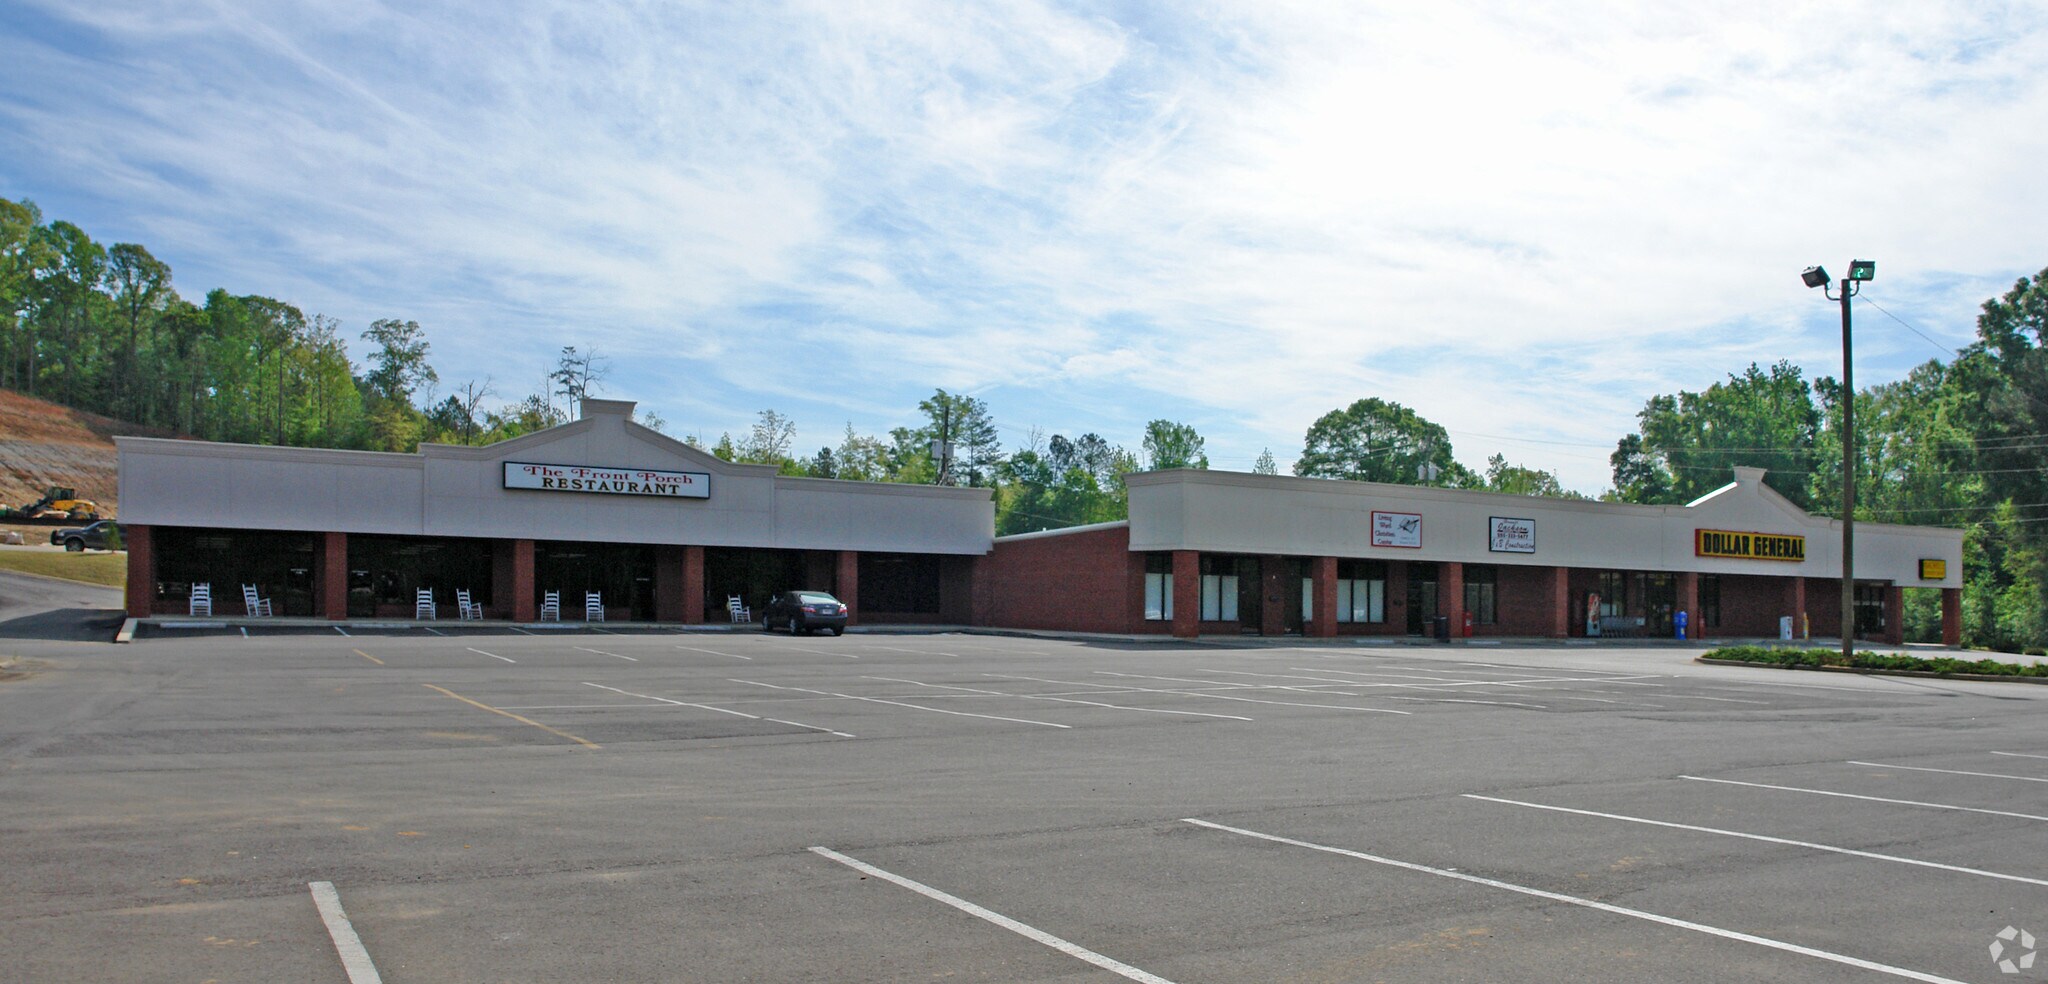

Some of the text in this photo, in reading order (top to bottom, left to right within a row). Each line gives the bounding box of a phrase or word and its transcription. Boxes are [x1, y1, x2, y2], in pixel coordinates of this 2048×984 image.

[523, 465, 693, 484] The Front Porch
[542, 477, 680, 495] RESTAURANT
[1703, 532, 1804, 558] DOLLAR GENERAL
